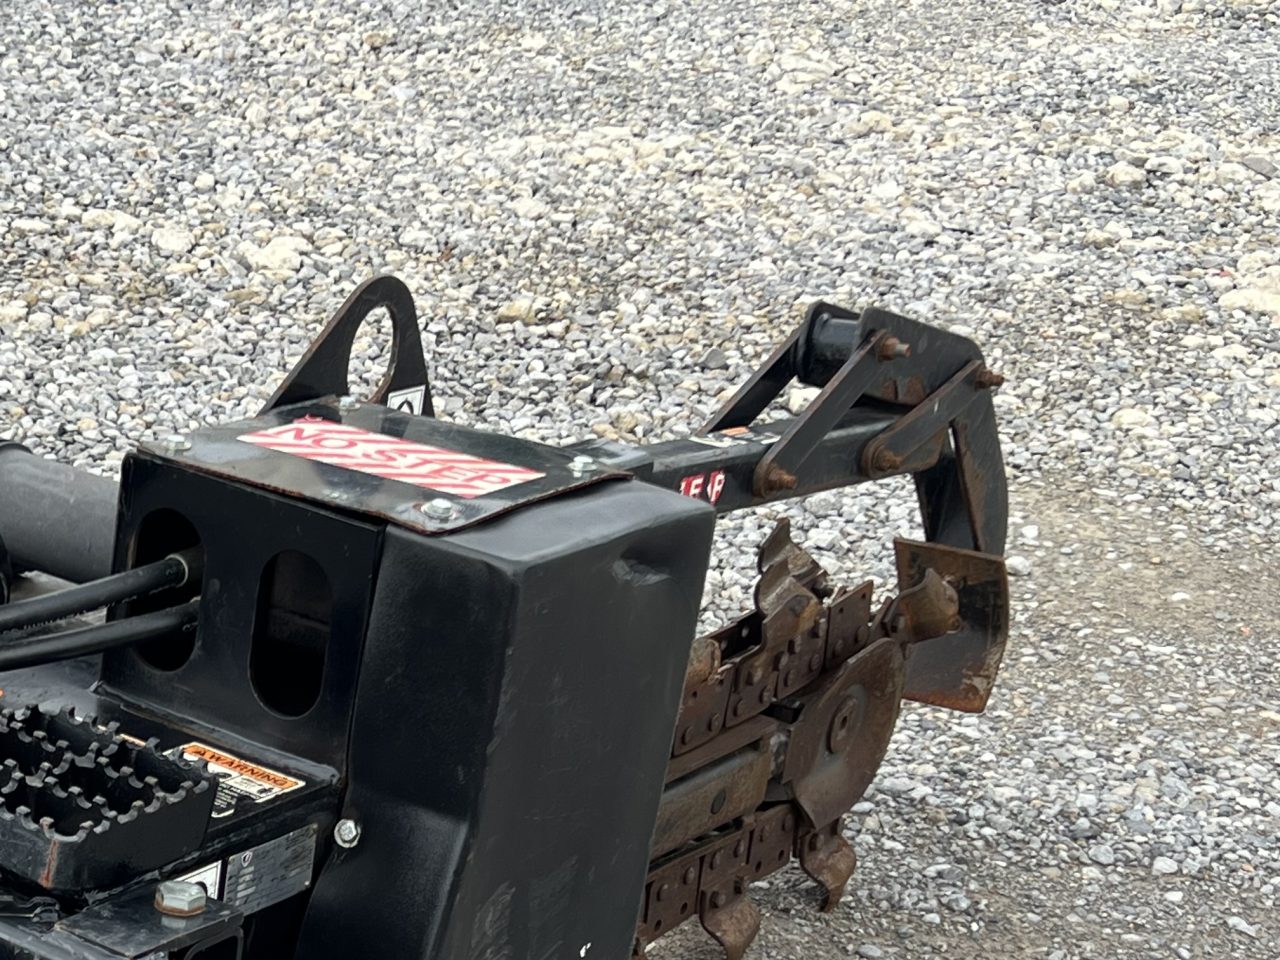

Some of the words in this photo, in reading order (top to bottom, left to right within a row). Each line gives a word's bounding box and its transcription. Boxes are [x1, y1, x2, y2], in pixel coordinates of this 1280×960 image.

[274, 426, 358, 450] NO
[362, 449, 512, 485] STEP
[209, 754, 288, 787] WARNING
